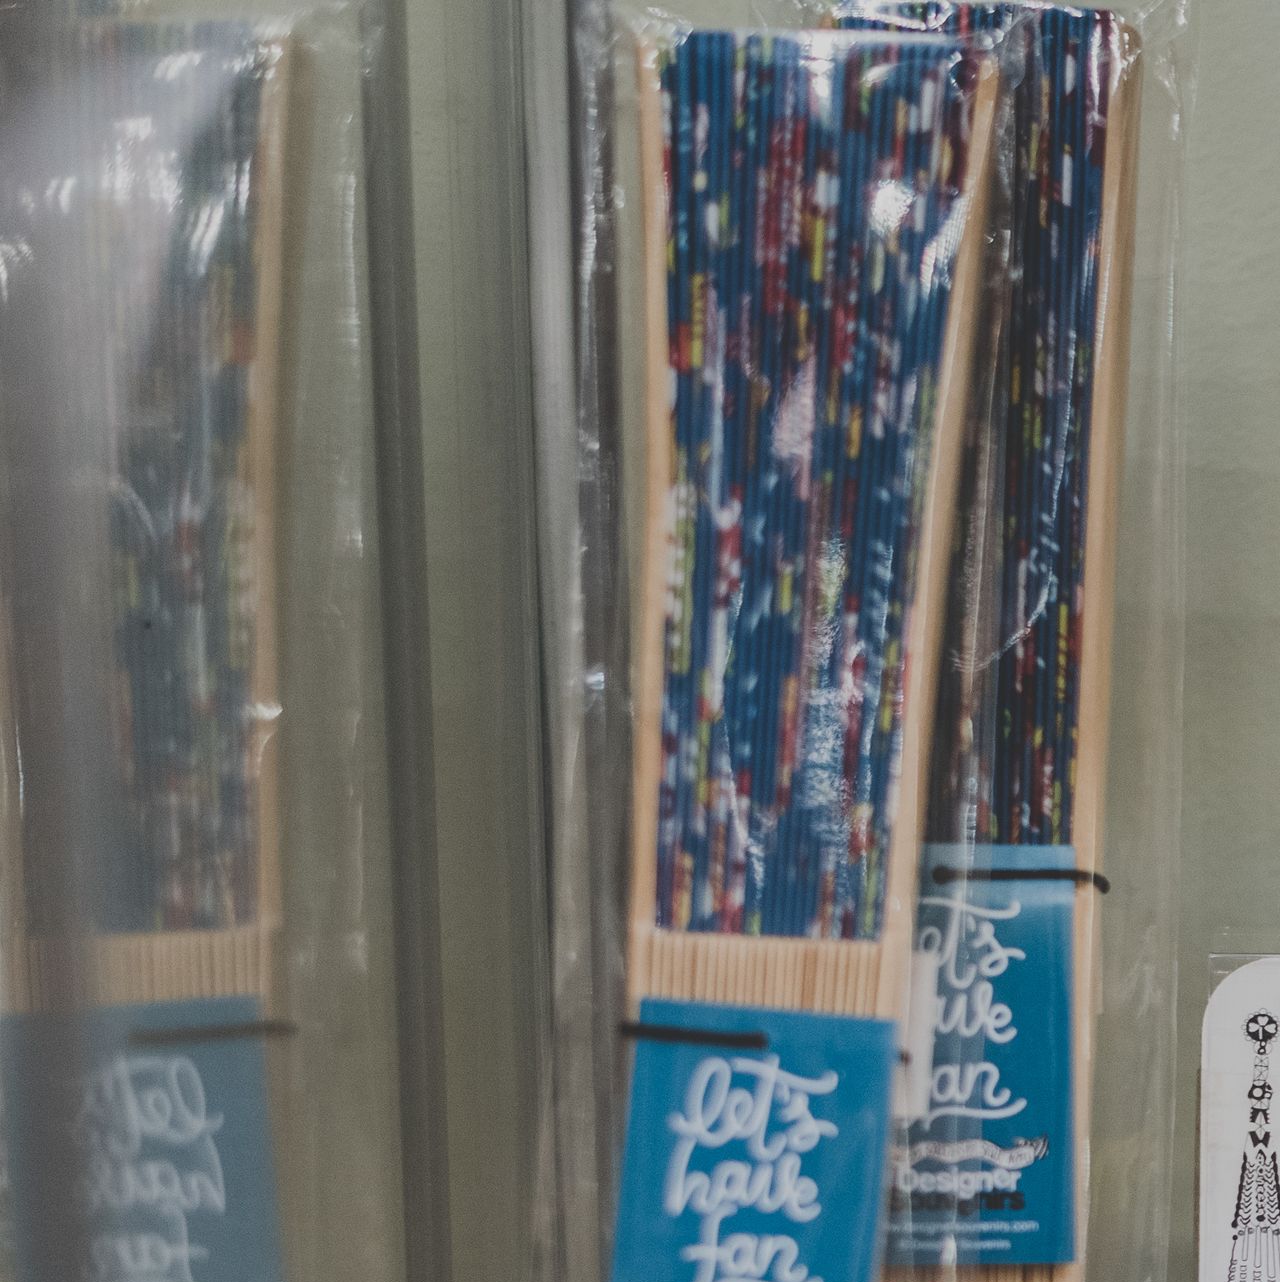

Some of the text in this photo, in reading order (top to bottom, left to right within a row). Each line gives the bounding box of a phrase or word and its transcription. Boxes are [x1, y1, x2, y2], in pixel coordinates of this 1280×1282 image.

[918, 897, 1027, 990] et's
[900, 1061, 1028, 1132] an
[667, 1133, 823, 1224] have
